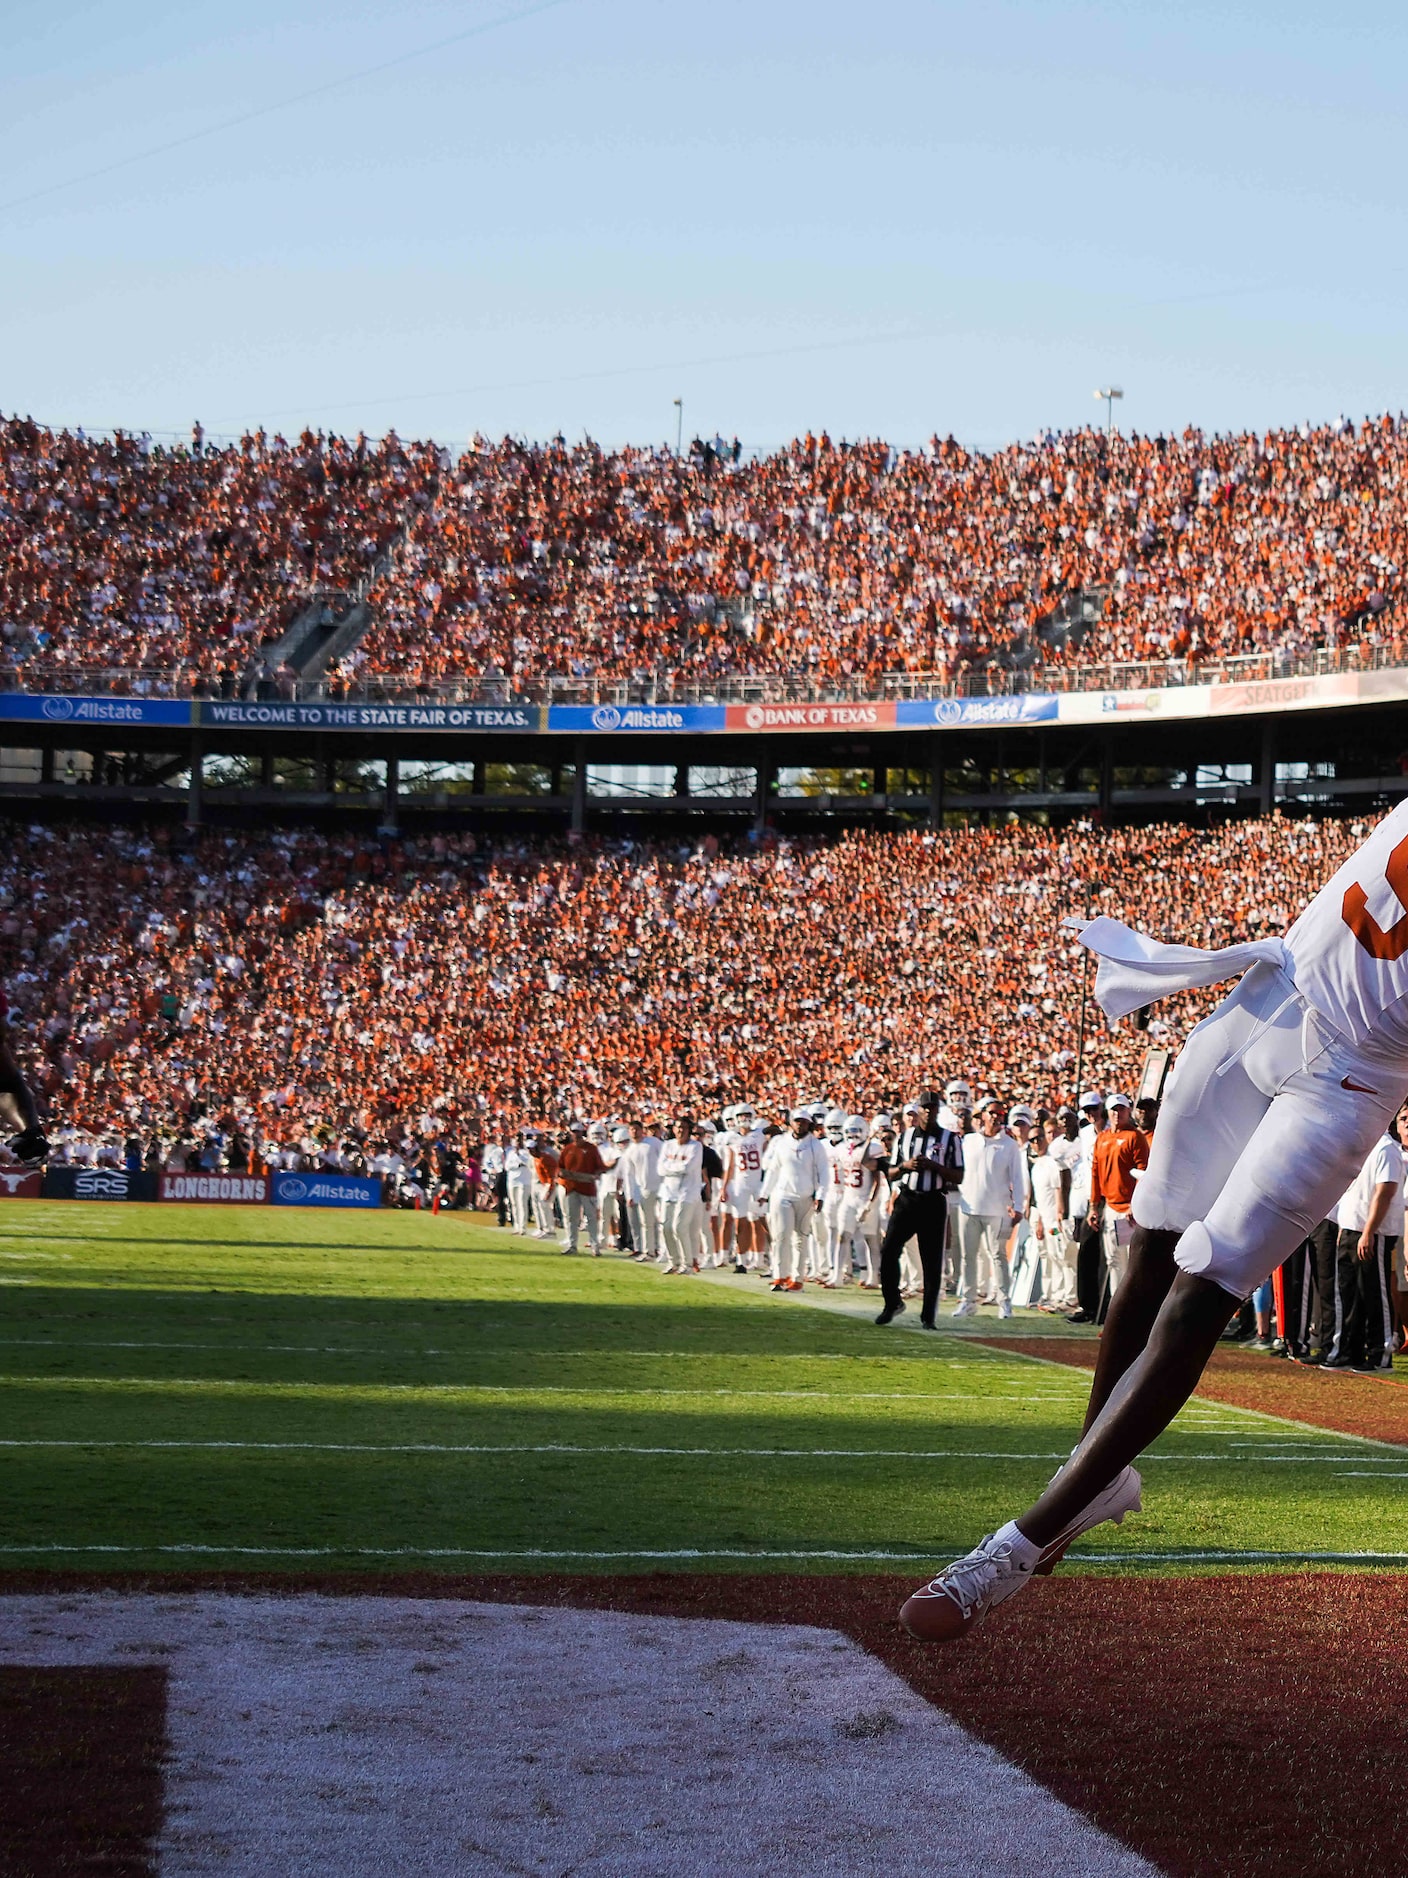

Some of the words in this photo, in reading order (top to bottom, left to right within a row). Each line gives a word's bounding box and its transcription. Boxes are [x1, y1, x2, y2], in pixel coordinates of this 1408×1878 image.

[74, 702, 143, 720] Allstate
[212, 706, 296, 723] WELCOME
[300, 709, 322, 724] TO
[326, 709, 357, 725] THE
[361, 709, 406, 725] STATE
[410, 709, 446, 725] FAIR
[449, 710, 473, 726] OF
[620, 710, 683, 728] Allstate
[765, 708, 805, 725] BANK
[808, 708, 828, 724] OF
[830, 707, 877, 724] TEXAS
[962, 702, 1018, 720] Allstate
[738, 1151, 760, 1171] 39
[75, 1178, 128, 1194] SRS
[164, 1177, 266, 1200] LONGHORNS
[308, 1183, 370, 1199] Allstate
